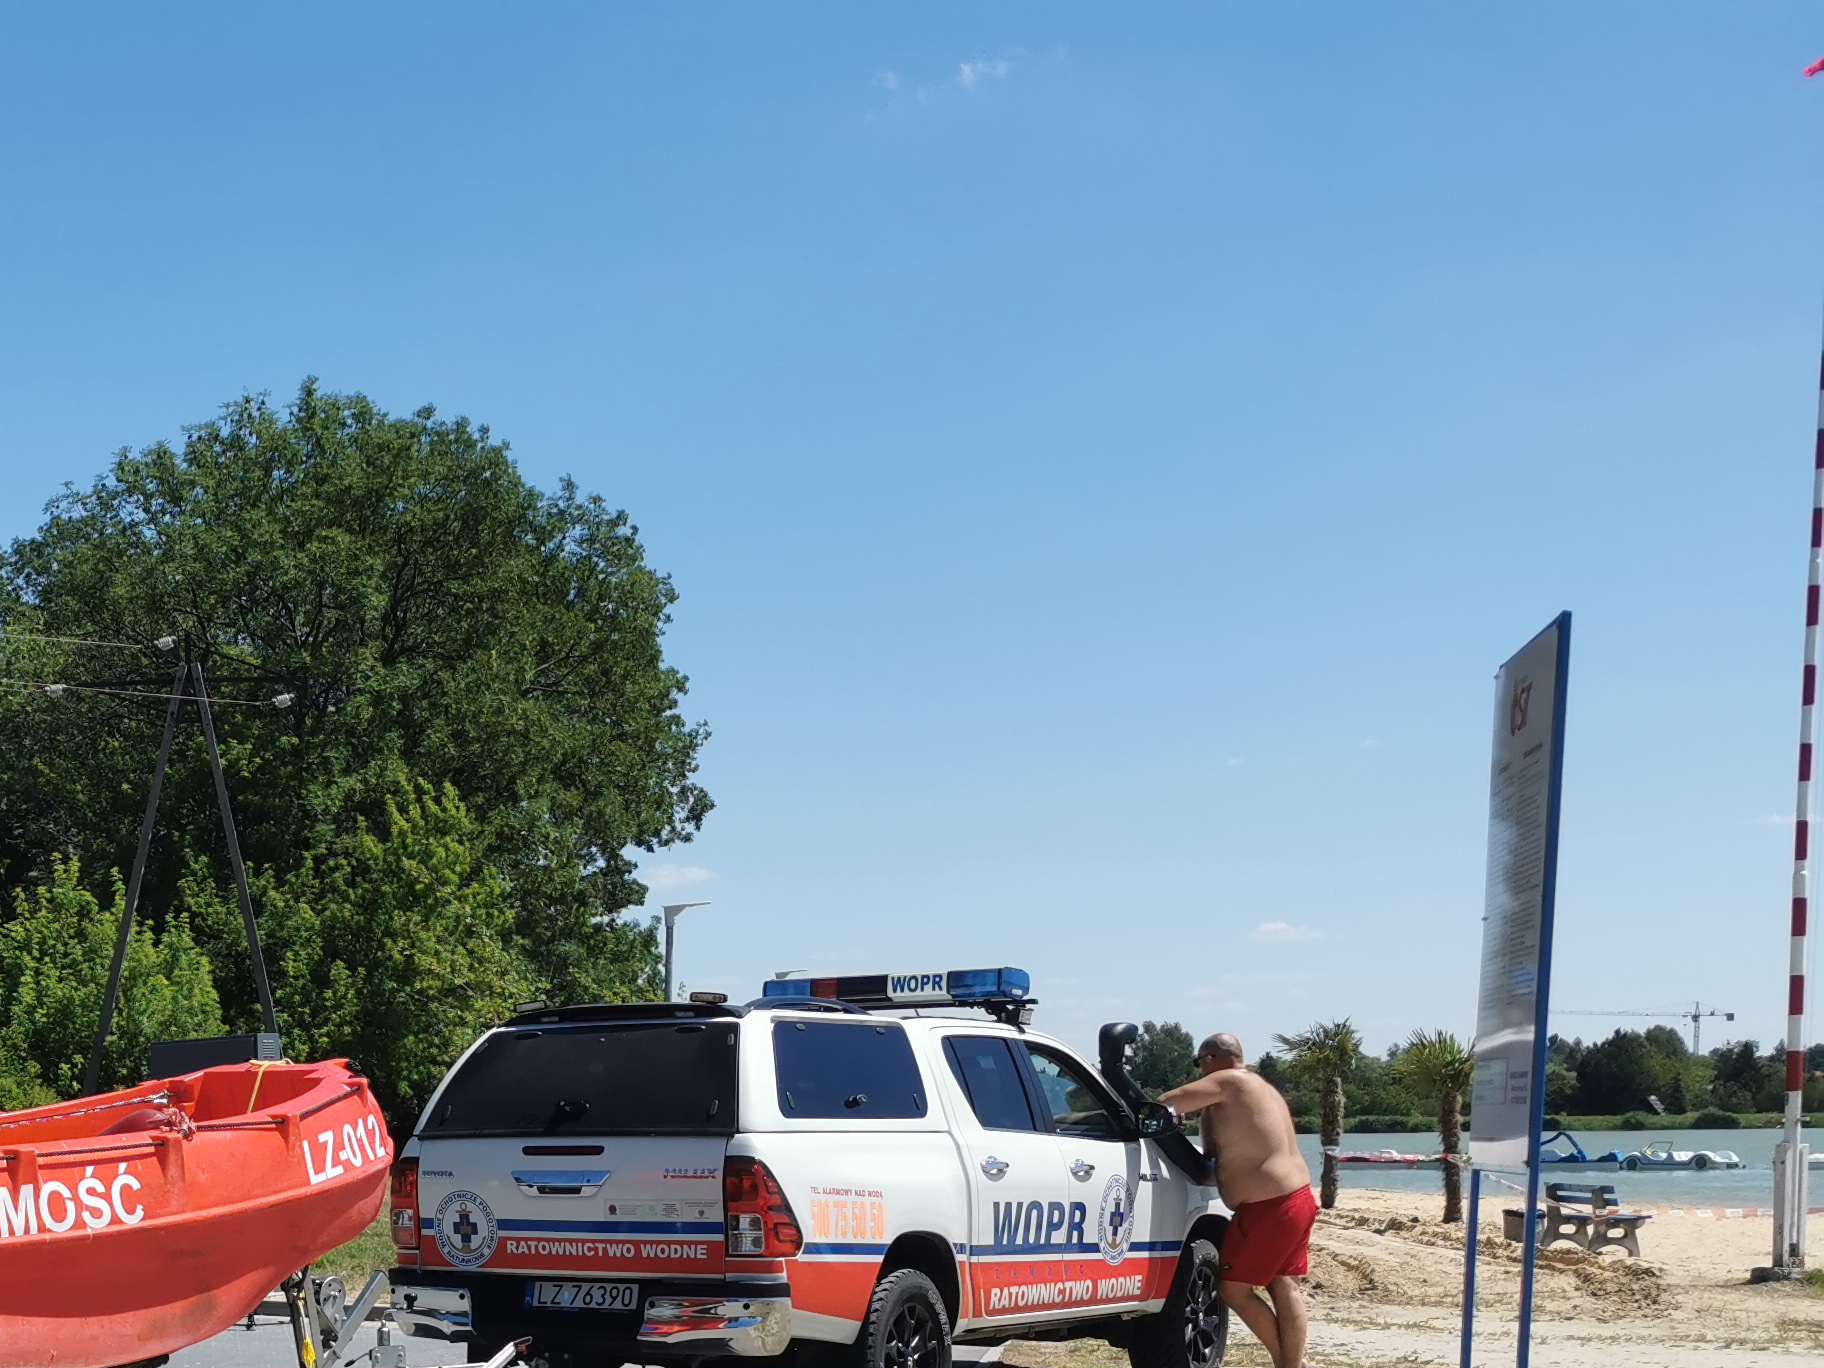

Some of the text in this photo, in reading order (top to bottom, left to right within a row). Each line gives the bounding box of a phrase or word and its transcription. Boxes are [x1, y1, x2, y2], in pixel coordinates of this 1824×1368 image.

[891, 974, 943, 993] WOPR
[302, 1114, 386, 1186] LZ-012
[822, 1187, 854, 1196] ALARMOWY
[854, 1189, 867, 1197] NAD
[436, 1192, 496, 1265] WODNE OCHOTNICZE POGOTOWIE RATUNKOWE
[810, 1199, 885, 1239] 500 75 50 50
[992, 1200, 1087, 1246] WOPR
[506, 1240, 708, 1259] RATOWNICTWO WODNE
[537, 1284, 634, 1307] LZ 76390
[989, 1274, 1143, 1310] RATOWNICTWO WODNE
